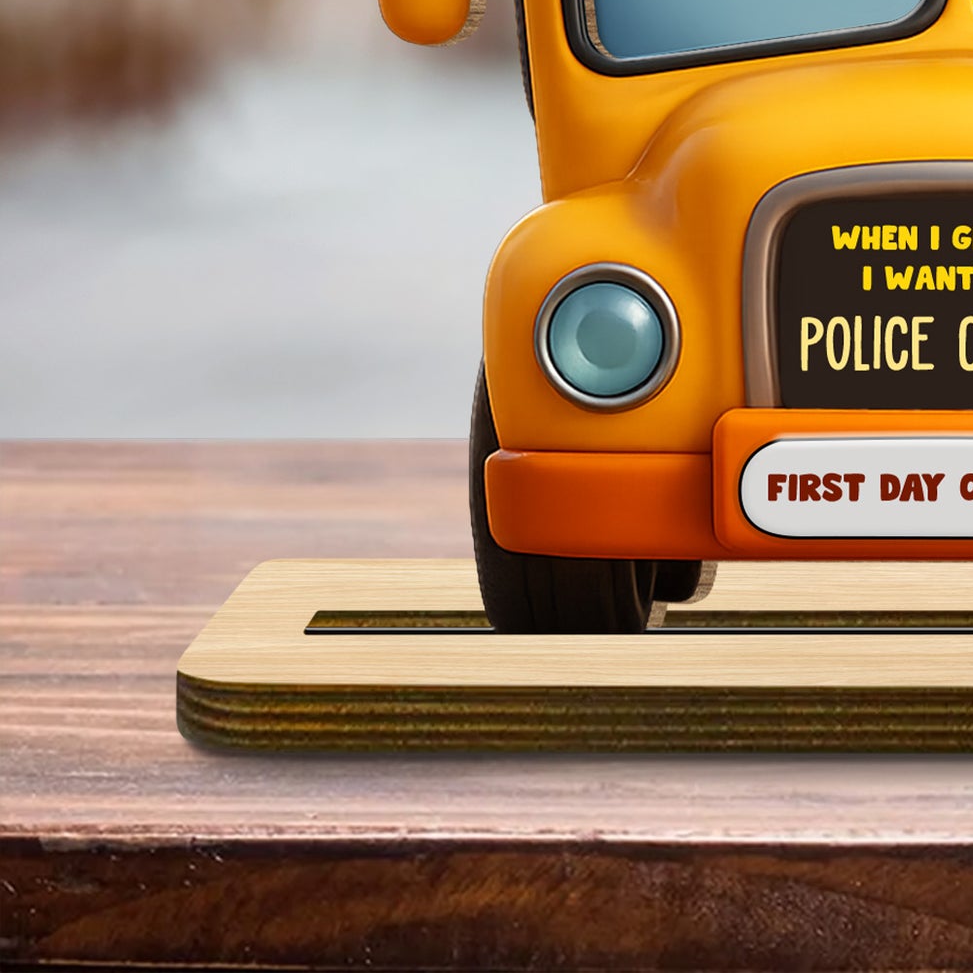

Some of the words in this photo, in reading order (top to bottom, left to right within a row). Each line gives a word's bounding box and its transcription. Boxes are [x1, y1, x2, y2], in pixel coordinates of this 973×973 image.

[831, 224, 918, 251] WHEN
[930, 225, 940, 251] I
[862, 265, 872, 291] I
[800, 315, 935, 372] POLICE
[767, 472, 866, 502] FIRST
[880, 473, 946, 502] DAY
